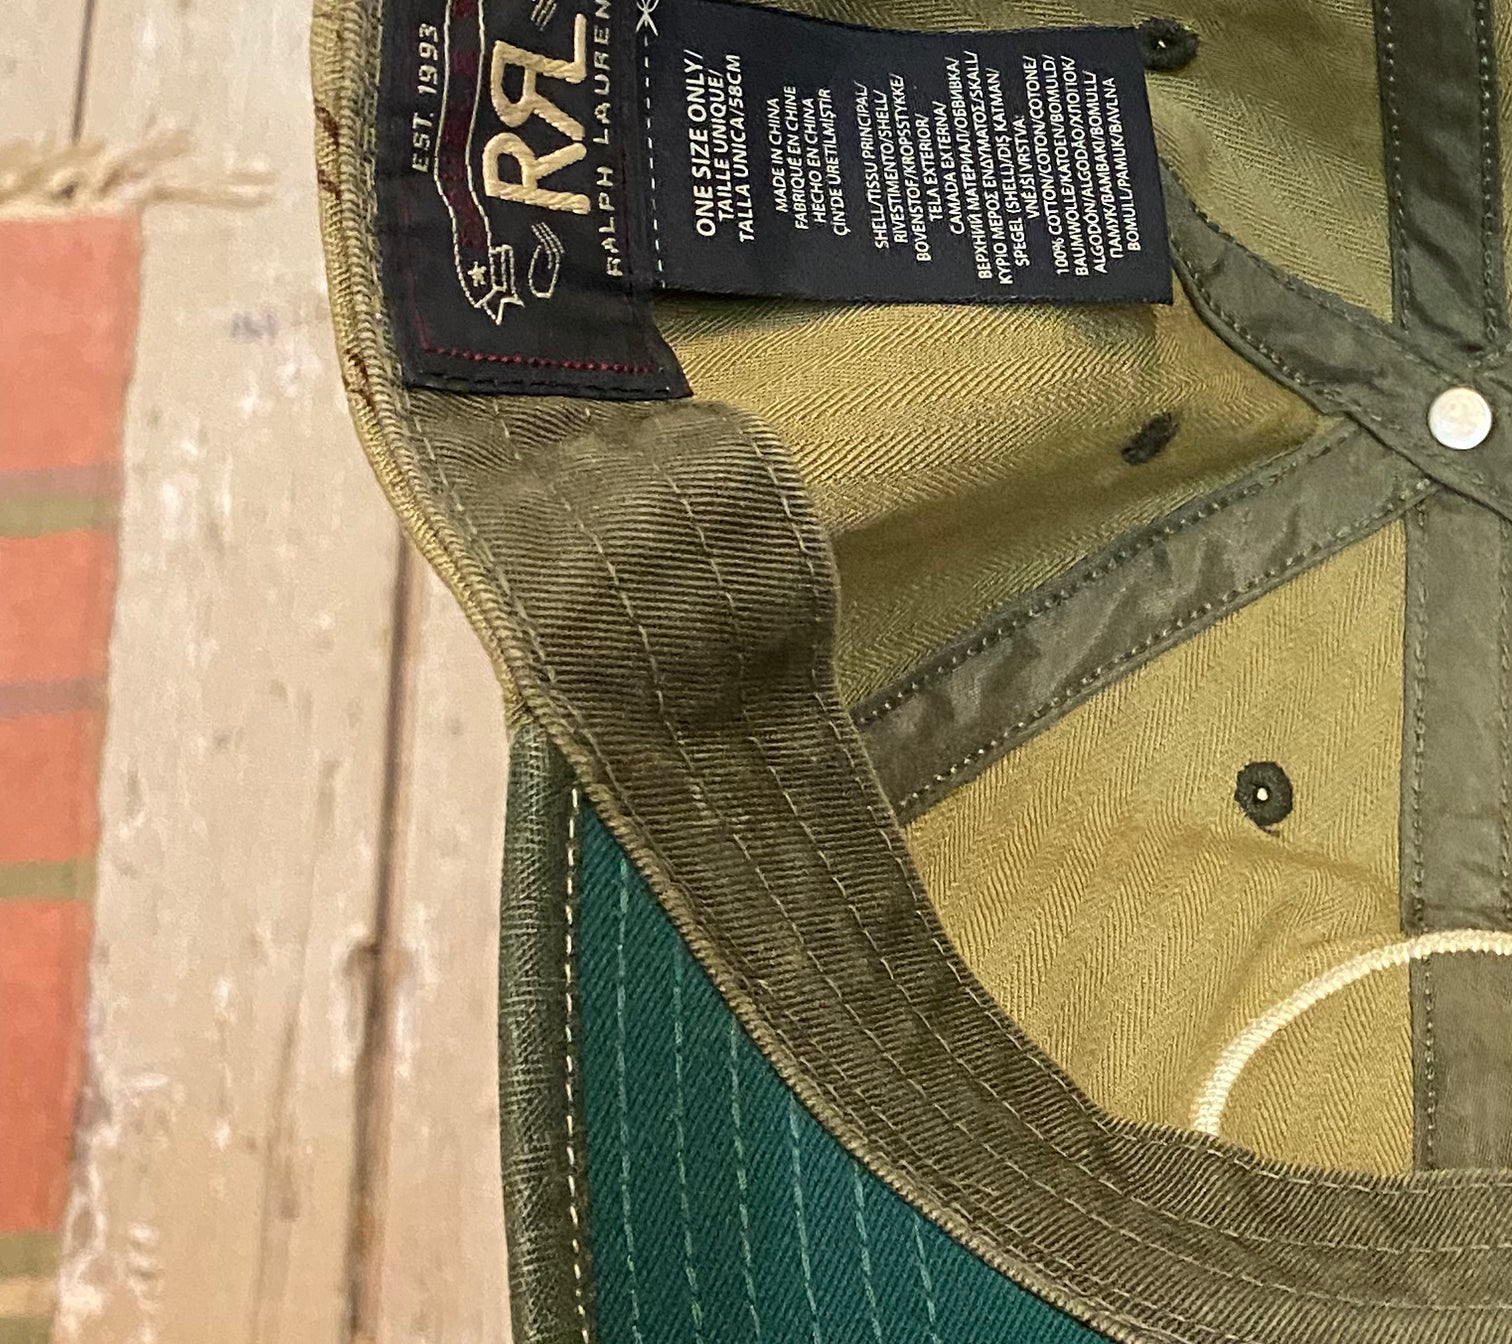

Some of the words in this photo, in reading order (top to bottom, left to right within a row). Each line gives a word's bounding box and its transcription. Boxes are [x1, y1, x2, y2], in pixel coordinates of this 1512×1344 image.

[417, 23, 439, 95] 1993
[684, 49, 707, 122] ONLY/
[708, 69, 728, 152] UNIQUE/
[726, 54, 749, 178] UNICA/58CM
[767, 98, 783, 145] CHINA
[784, 86, 798, 131] CHINE
[802, 98, 817, 144] CHINA
[854, 81, 875, 159] PRINCIPAL/
[986, 67, 1007, 132] KATMAN/
[412, 113, 435, 173] EST.
[689, 129, 712, 179] SIZE
[771, 149, 783, 164] IN
[787, 135, 801, 154] EN
[806, 148, 820, 167] EN
[873, 89, 908, 243] RIVESTIMENTO/SHELL/
[915, 113, 937, 184] EXTERIOR/
[932, 101, 955, 169] EXTERNA/
[1023, 55, 1063, 235] COTTON/COTON/COTONE/
[1102, 78, 1141, 251] BOMULL/PAMUK/BAVLNA
[594, 166, 624, 276] RALPH
[693, 186, 716, 236] ONE
[714, 159, 735, 221] TAILLE
[738, 184, 755, 242] TALLA
[771, 168, 788, 212] MADE
[787, 158, 809, 229] FABRIQUÉ
[809, 171, 827, 223] HECHO
[865, 161, 889, 249] SHELL/TISSU
[927, 188, 943, 222] TELA
[943, 172, 965, 235] CAMADA
[1011, 217, 1030, 267] SPEGEL
[1054, 238, 1070, 275] 100%
